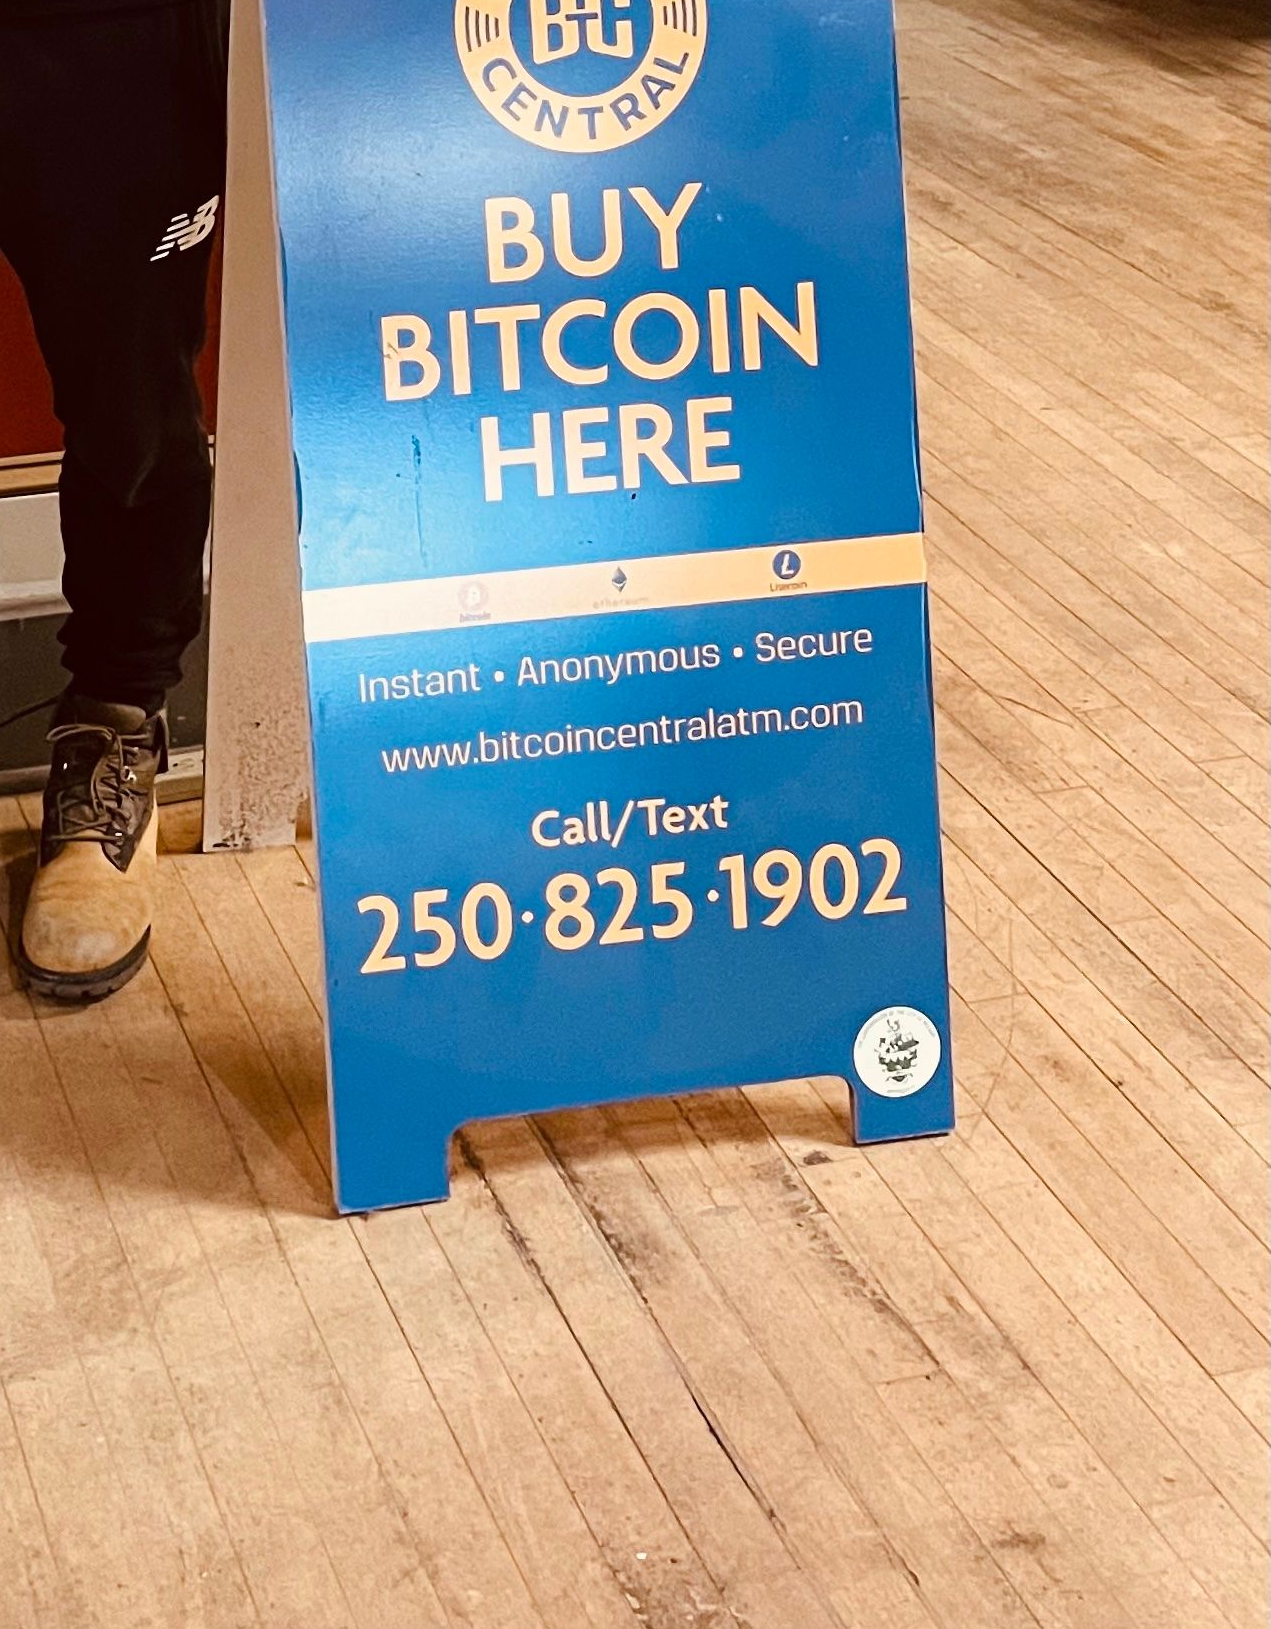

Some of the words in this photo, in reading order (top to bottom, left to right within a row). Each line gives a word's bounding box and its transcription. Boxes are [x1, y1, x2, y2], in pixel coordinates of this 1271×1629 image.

[481, 51, 690, 140] CENTRAL
[484, 182, 703, 283] BUY
[380, 281, 819, 402] BITCOIN
[480, 396, 741, 502] HERE
[359, 662, 482, 704] Instant
[517, 641, 721, 689] Anonymous
[755, 626, 874, 663] Secure
[381, 697, 864, 774] www.bitcoincentralatm.com
[531, 794, 729, 849] Call/Text
